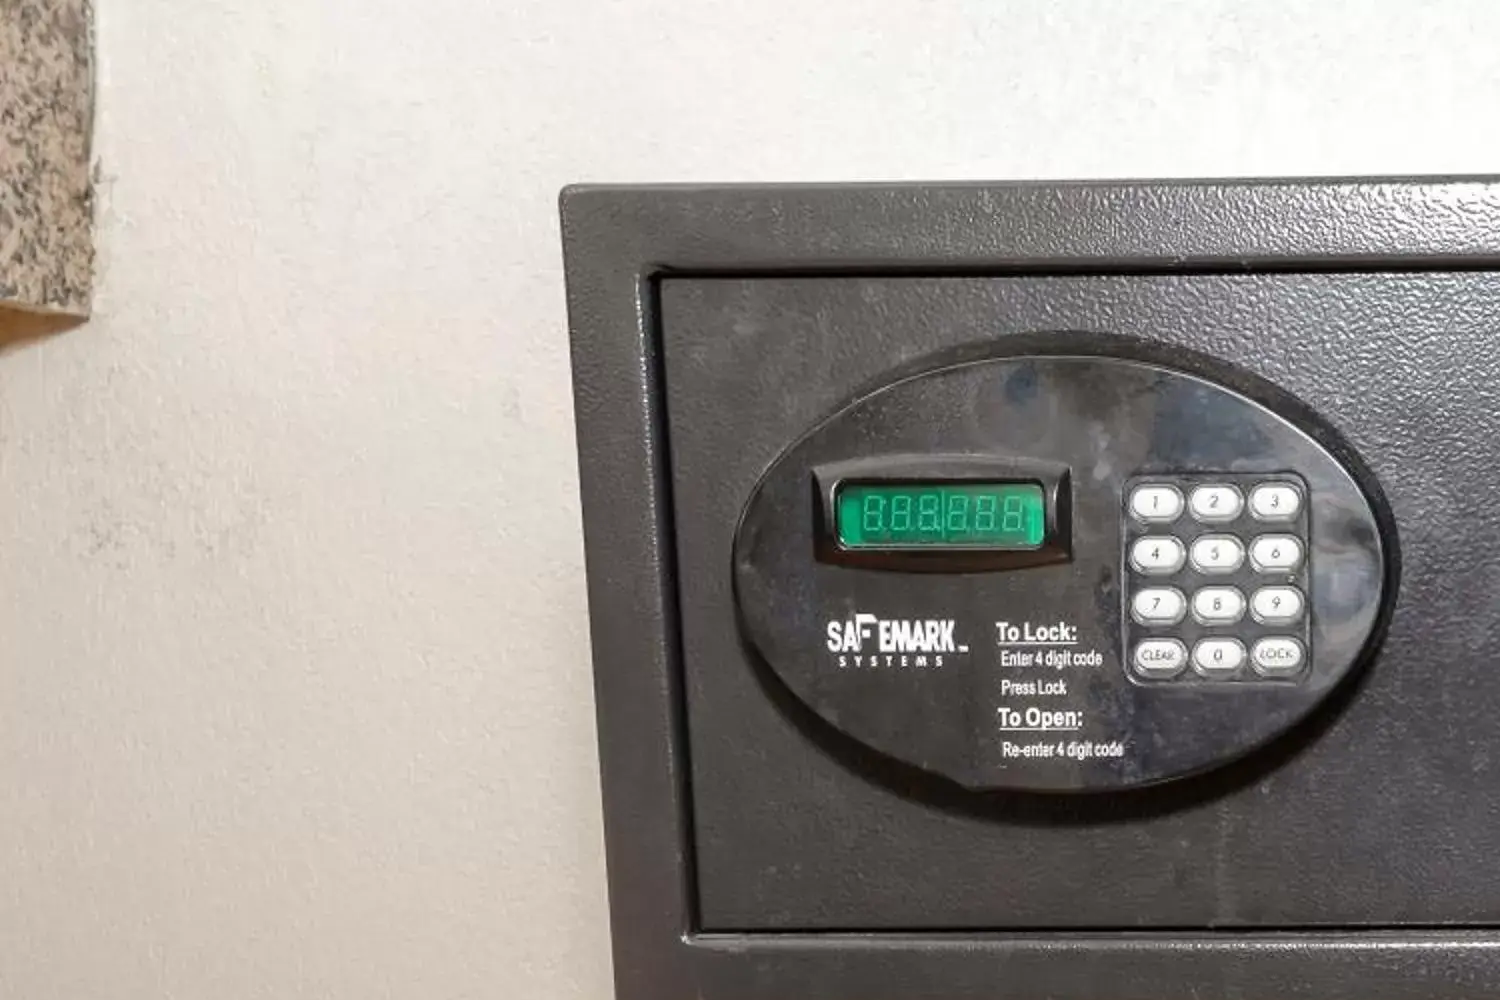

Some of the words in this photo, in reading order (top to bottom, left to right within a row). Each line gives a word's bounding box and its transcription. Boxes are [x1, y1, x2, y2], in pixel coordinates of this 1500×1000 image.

[1209, 495, 1220, 509] 2
[1271, 494, 1279, 508] 3
[1151, 547, 1160, 560] 4
[1211, 546, 1220, 560] 5
[1271, 548, 1281, 559] 6
[1152, 597, 1161, 610] 7
[1213, 597, 1222, 611] 8
[1272, 596, 1281, 609] 9
[827, 613, 955, 652] SAFEMARK
[996, 621, 1021, 641] To
[1024, 621, 1078, 641] Lock:
[839, 655, 944, 667] SYSTEMS
[1001, 650, 1033, 666] Enter
[1035, 651, 1043, 666] 4
[1045, 650, 1071, 670] digit
[1073, 650, 1103, 666] code
[1141, 649, 1175, 661] CLEAR
[1213, 649, 1223, 661] 0
[1260, 648, 1293, 659] LOCK
[1001, 679, 1036, 695] Press
[1038, 679, 1067, 695] Lock
[998, 708, 1021, 727] To
[1025, 708, 1083, 730] Open:
[1002, 742, 1055, 757] Re-enter
[1057, 742, 1065, 757] 4
[1066, 742, 1093, 761] digit
[1095, 742, 1123, 757] code
